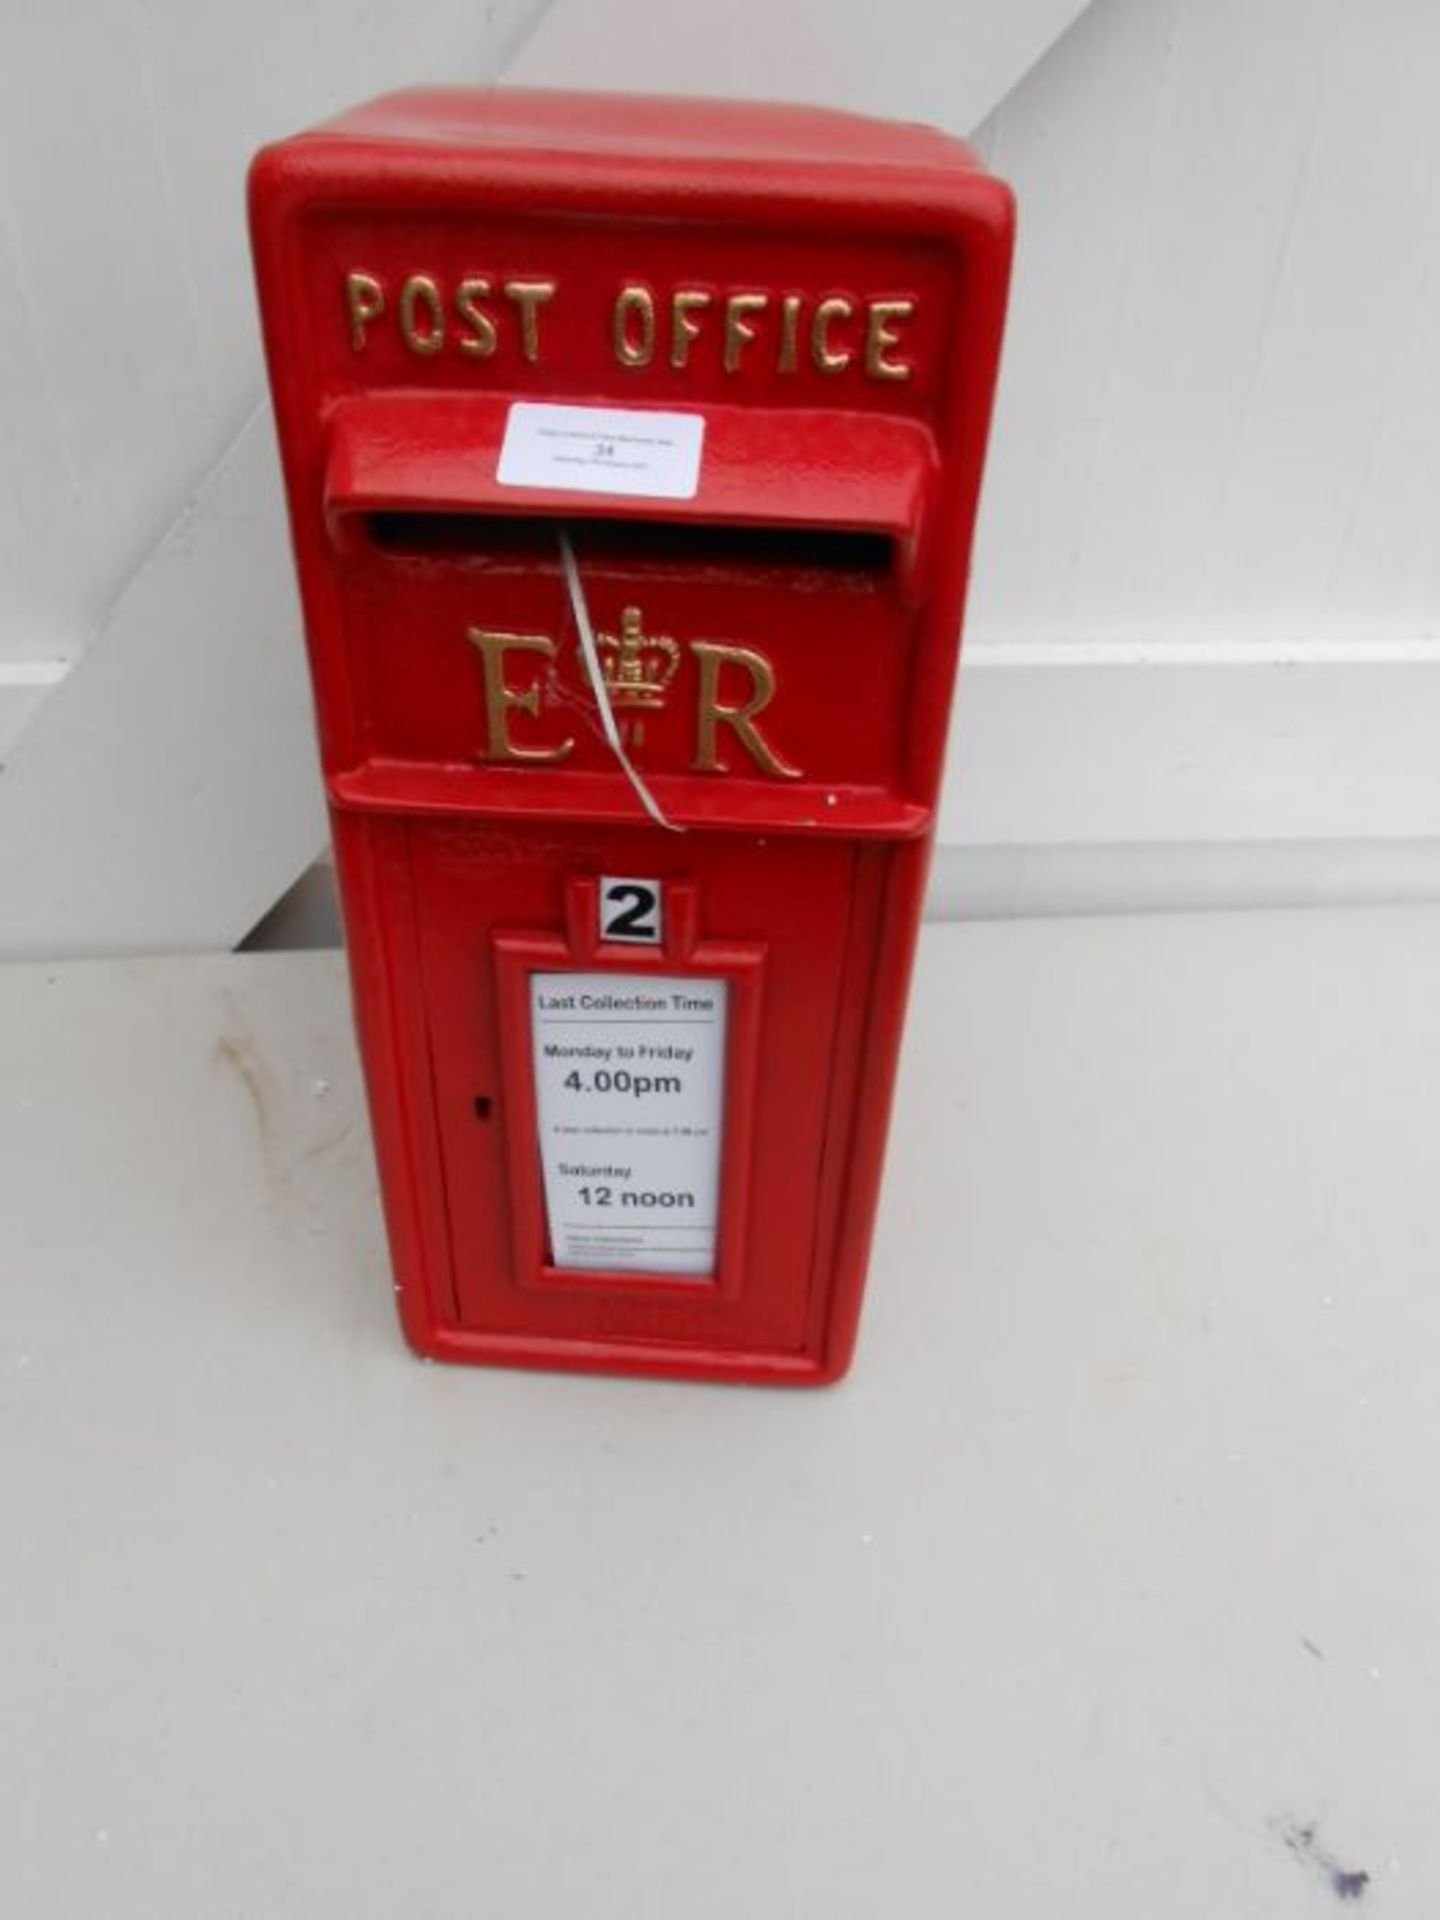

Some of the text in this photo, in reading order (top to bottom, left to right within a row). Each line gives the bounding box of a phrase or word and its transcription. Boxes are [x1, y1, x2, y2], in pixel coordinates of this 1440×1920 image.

[347, 272, 916, 379] POST OFFICE
[467, 626, 803, 778] E R
[604, 884, 657, 937] 2
[539, 995, 714, 1012] Last Collection Time
[544, 1045, 693, 1063] Monday to Friday
[563, 1070, 681, 1098] 4.00pm
[558, 1163, 632, 1180] Saturday
[577, 1186, 695, 1208] 12 noon
